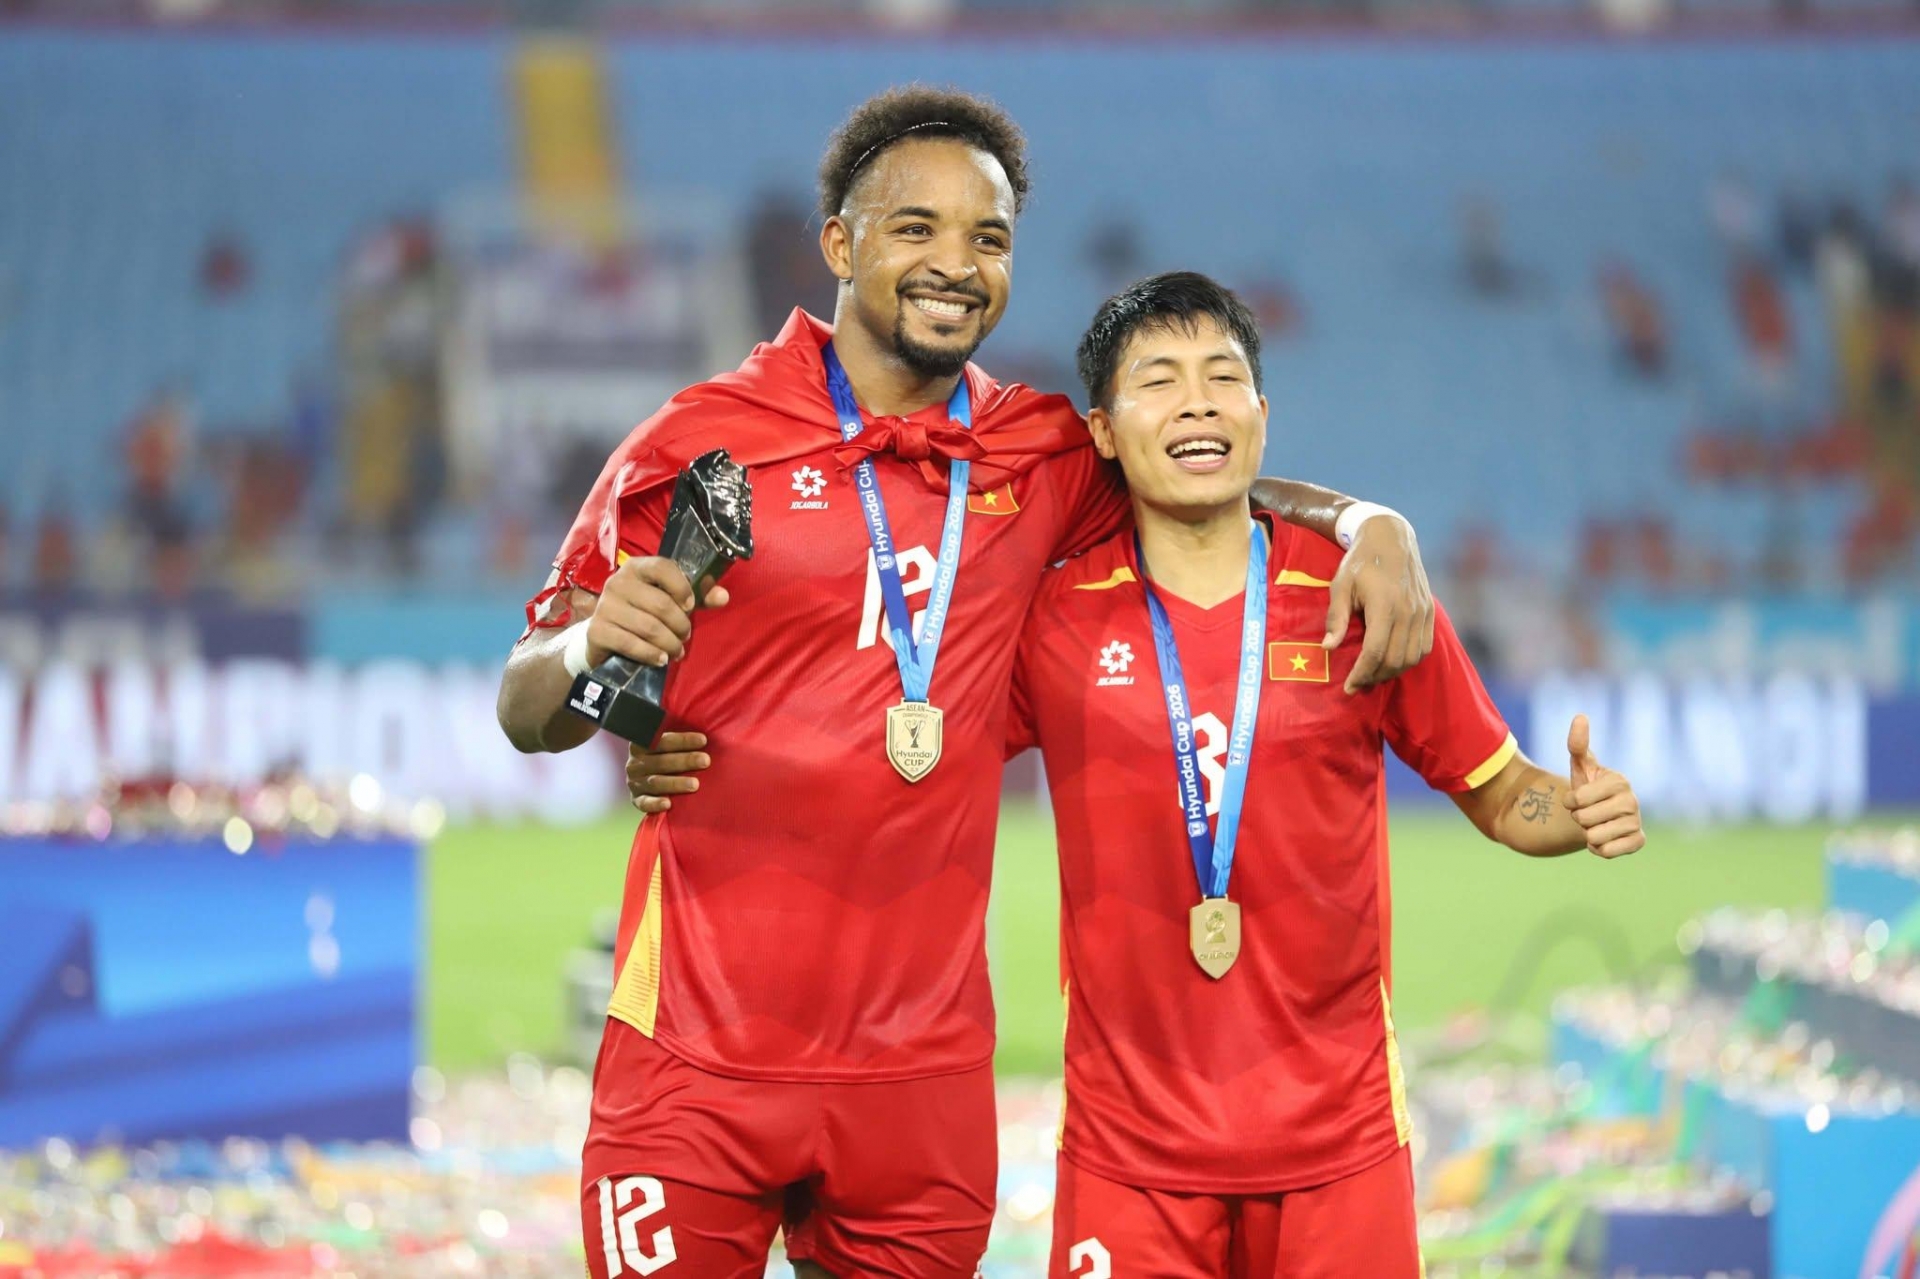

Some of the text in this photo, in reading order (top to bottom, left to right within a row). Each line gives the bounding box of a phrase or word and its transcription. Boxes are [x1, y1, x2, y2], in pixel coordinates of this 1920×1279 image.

[844, 422, 859, 440] 26
[861, 490, 889, 552] Hyundai
[928, 495, 963, 628] Hyundai Cup 2026
[906, 704, 926, 712] ASEAN
[1233, 619, 1261, 749] Hyundai Cup 2026
[896, 750, 933, 759] Hyundai
[904, 759, 925, 767] CUP
[1167, 684, 1202, 819] Hyundai Cup 2026
[597, 1176, 677, 1279] 12
